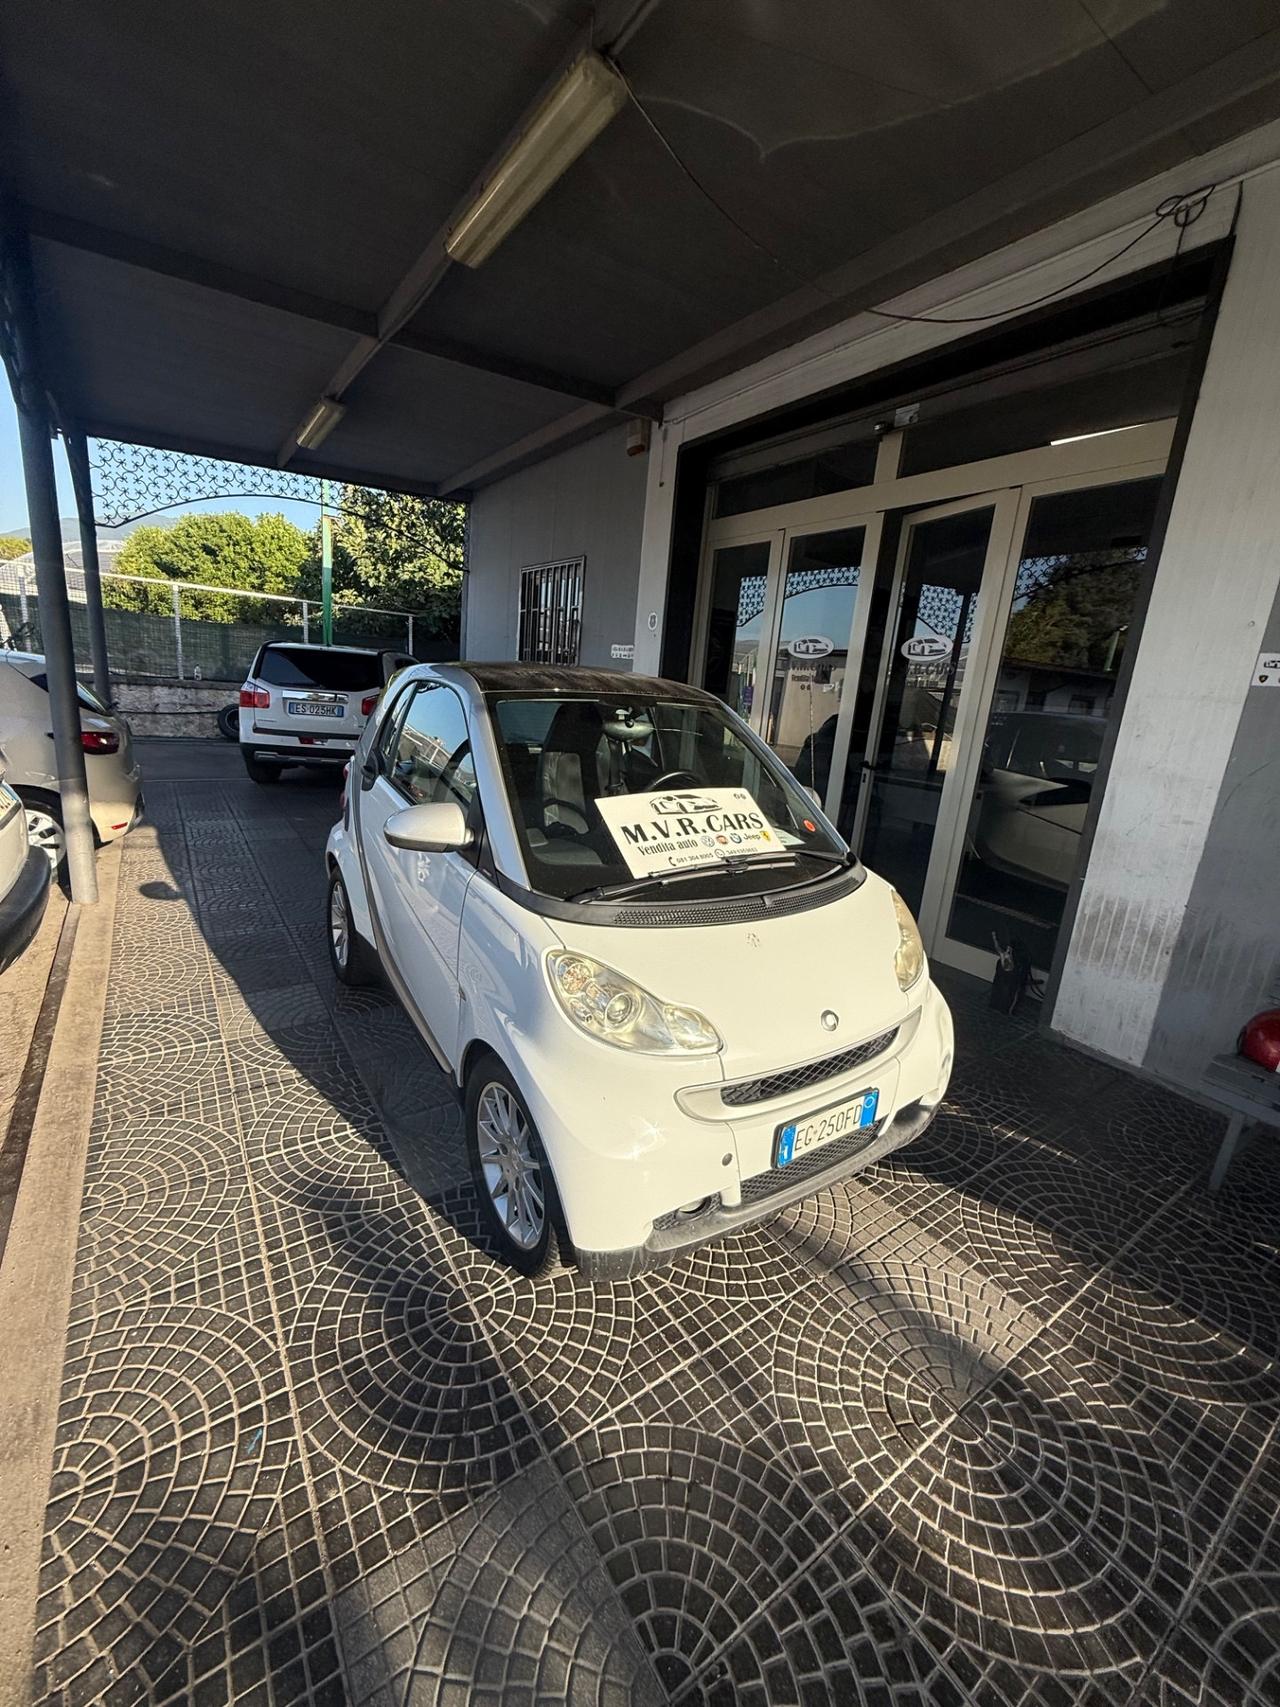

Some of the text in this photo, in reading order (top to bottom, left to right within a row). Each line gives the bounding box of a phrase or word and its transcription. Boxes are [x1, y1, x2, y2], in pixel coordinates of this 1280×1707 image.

[294, 701, 306, 713] ES
[620, 812, 764, 845] M.V.R.CARS
[637, 839, 698, 856] Vendita auto
[794, 1125, 814, 1151] EG
